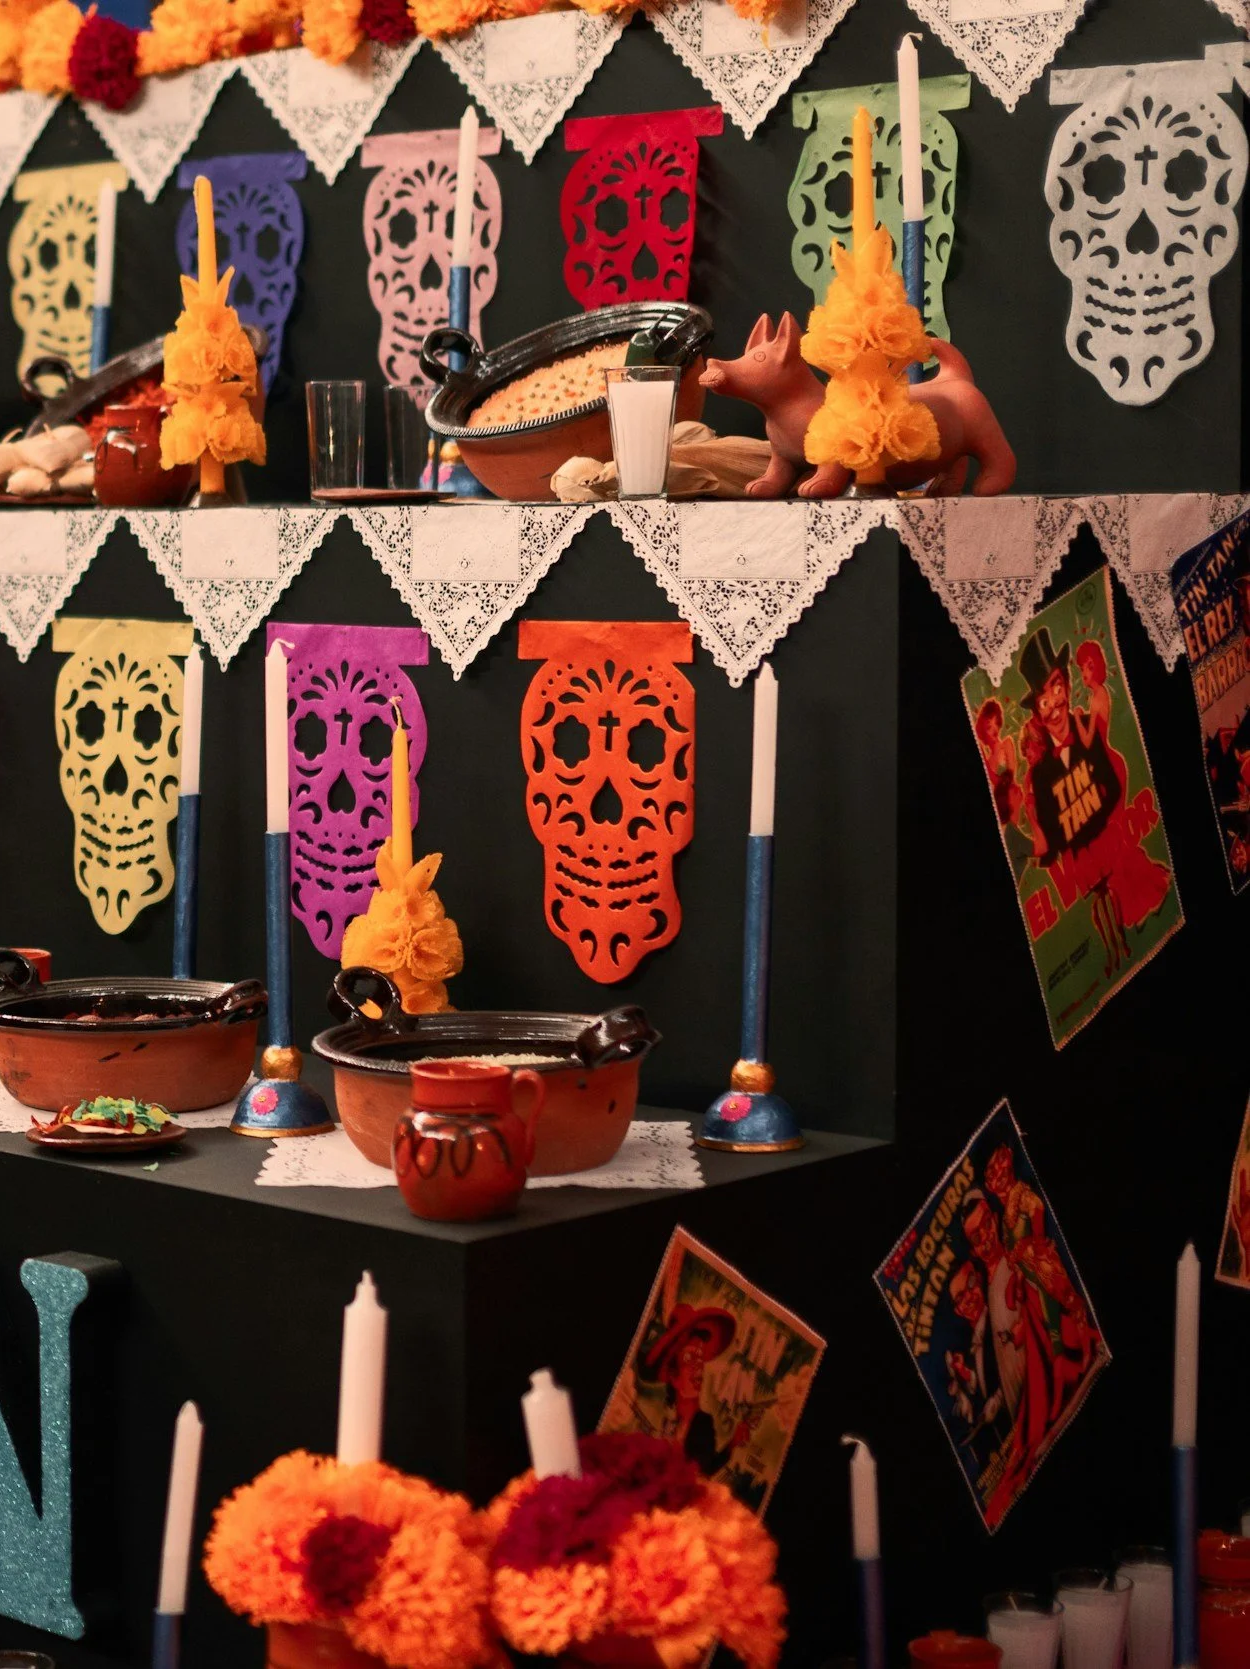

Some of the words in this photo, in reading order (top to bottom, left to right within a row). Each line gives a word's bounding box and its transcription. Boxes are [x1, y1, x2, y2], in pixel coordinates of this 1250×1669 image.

[1183, 621, 1207, 664] EL
[1204, 594, 1235, 650] REY
[1058, 783, 1102, 843] TAN
[1025, 885, 1059, 941] EL
